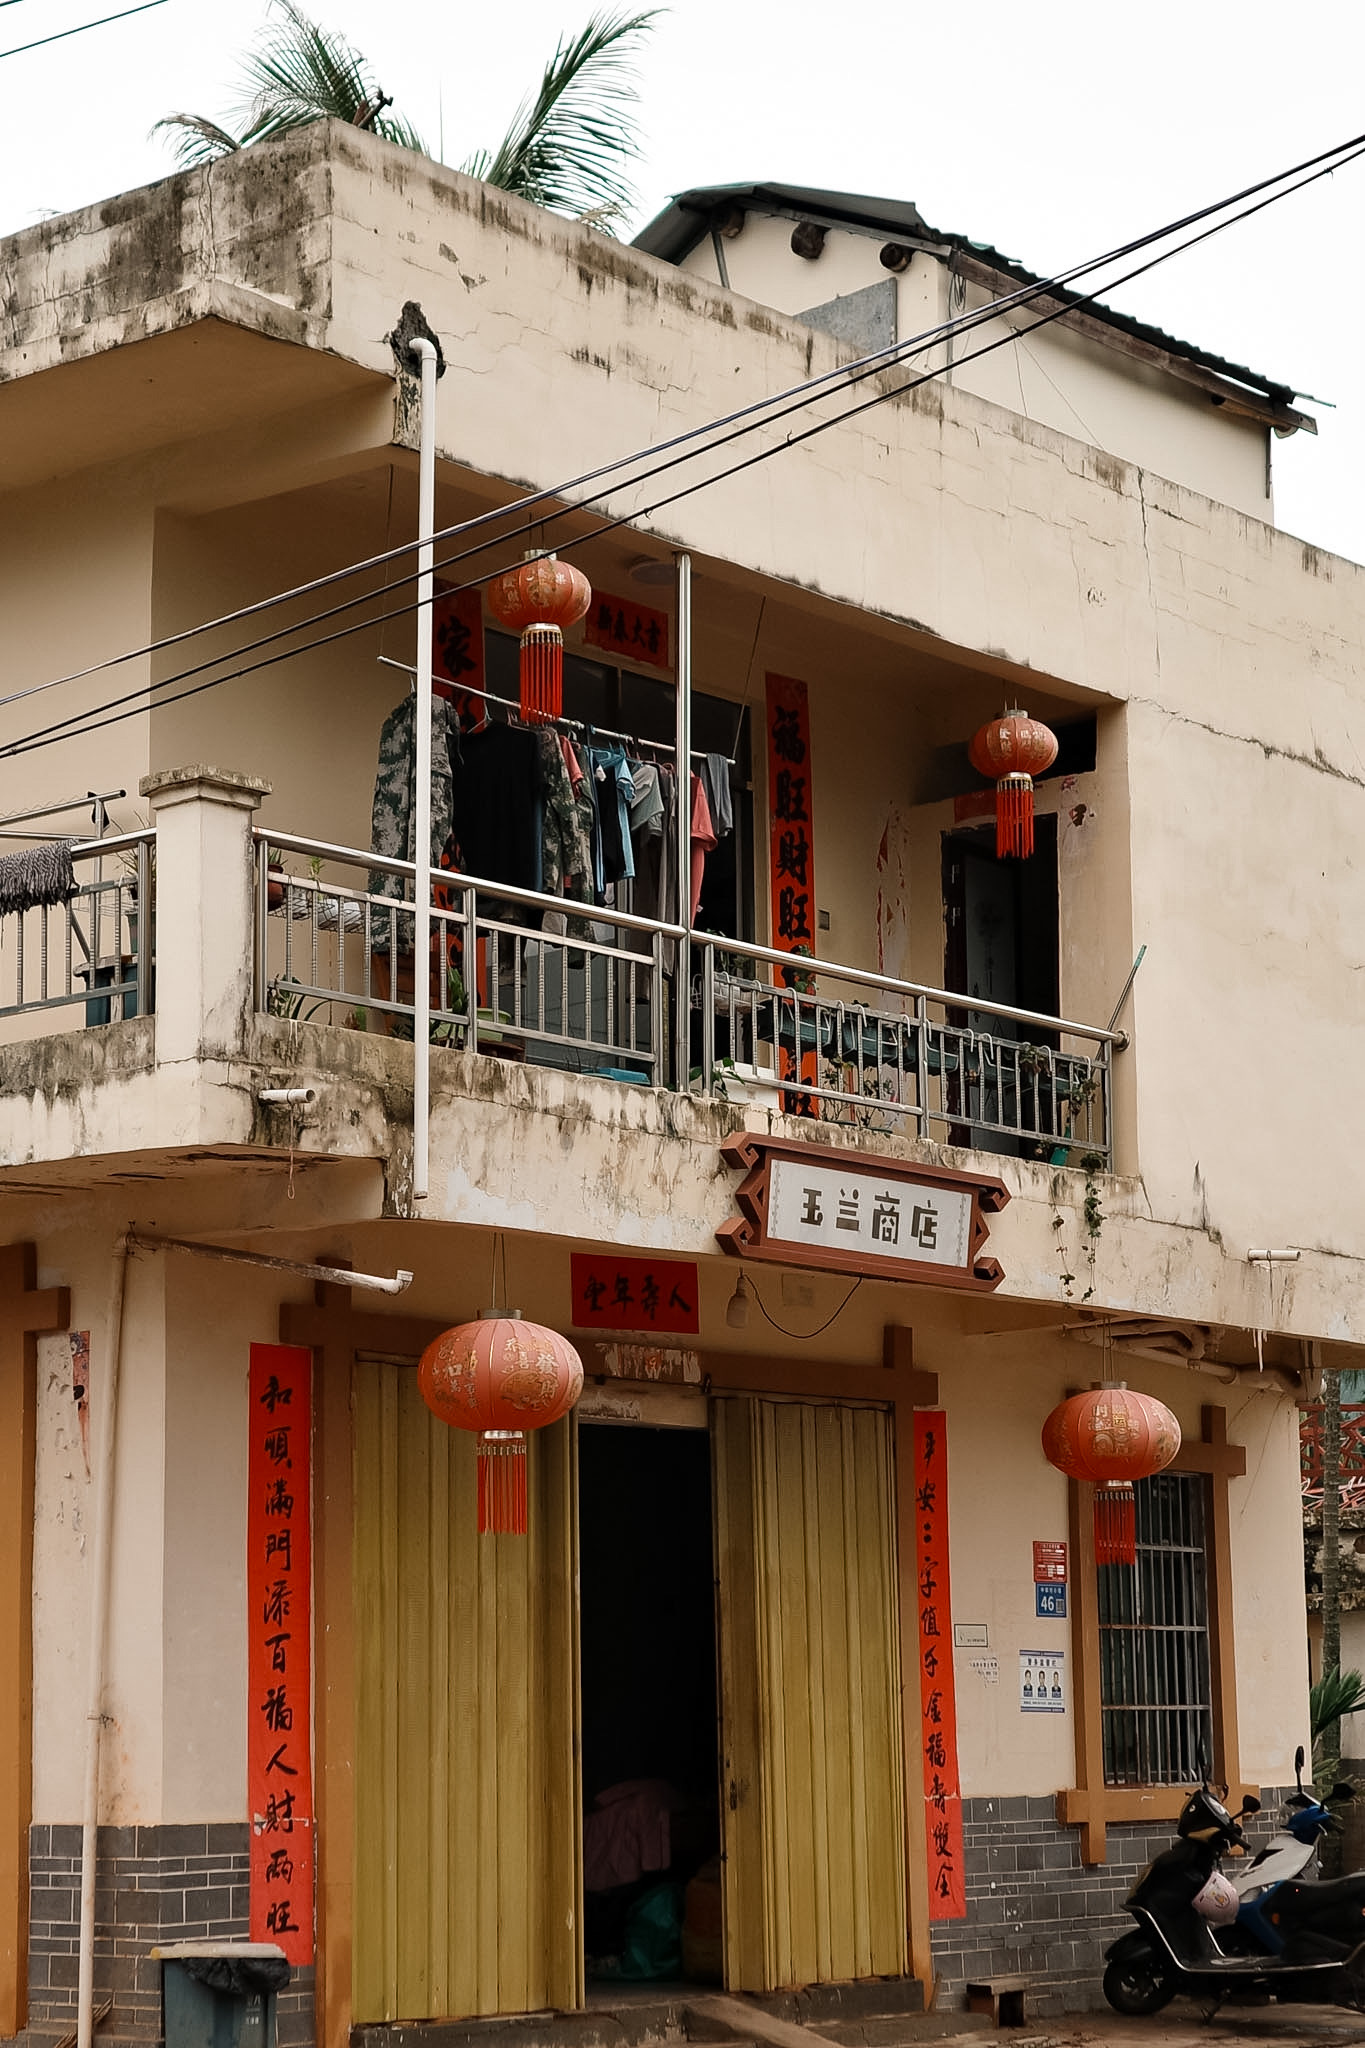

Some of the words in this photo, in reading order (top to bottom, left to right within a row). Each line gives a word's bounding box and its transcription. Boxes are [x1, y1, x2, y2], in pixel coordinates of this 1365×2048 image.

[799, 1186, 938, 1250] 玉兰商店
[1040, 1595, 1055, 1612] 46
